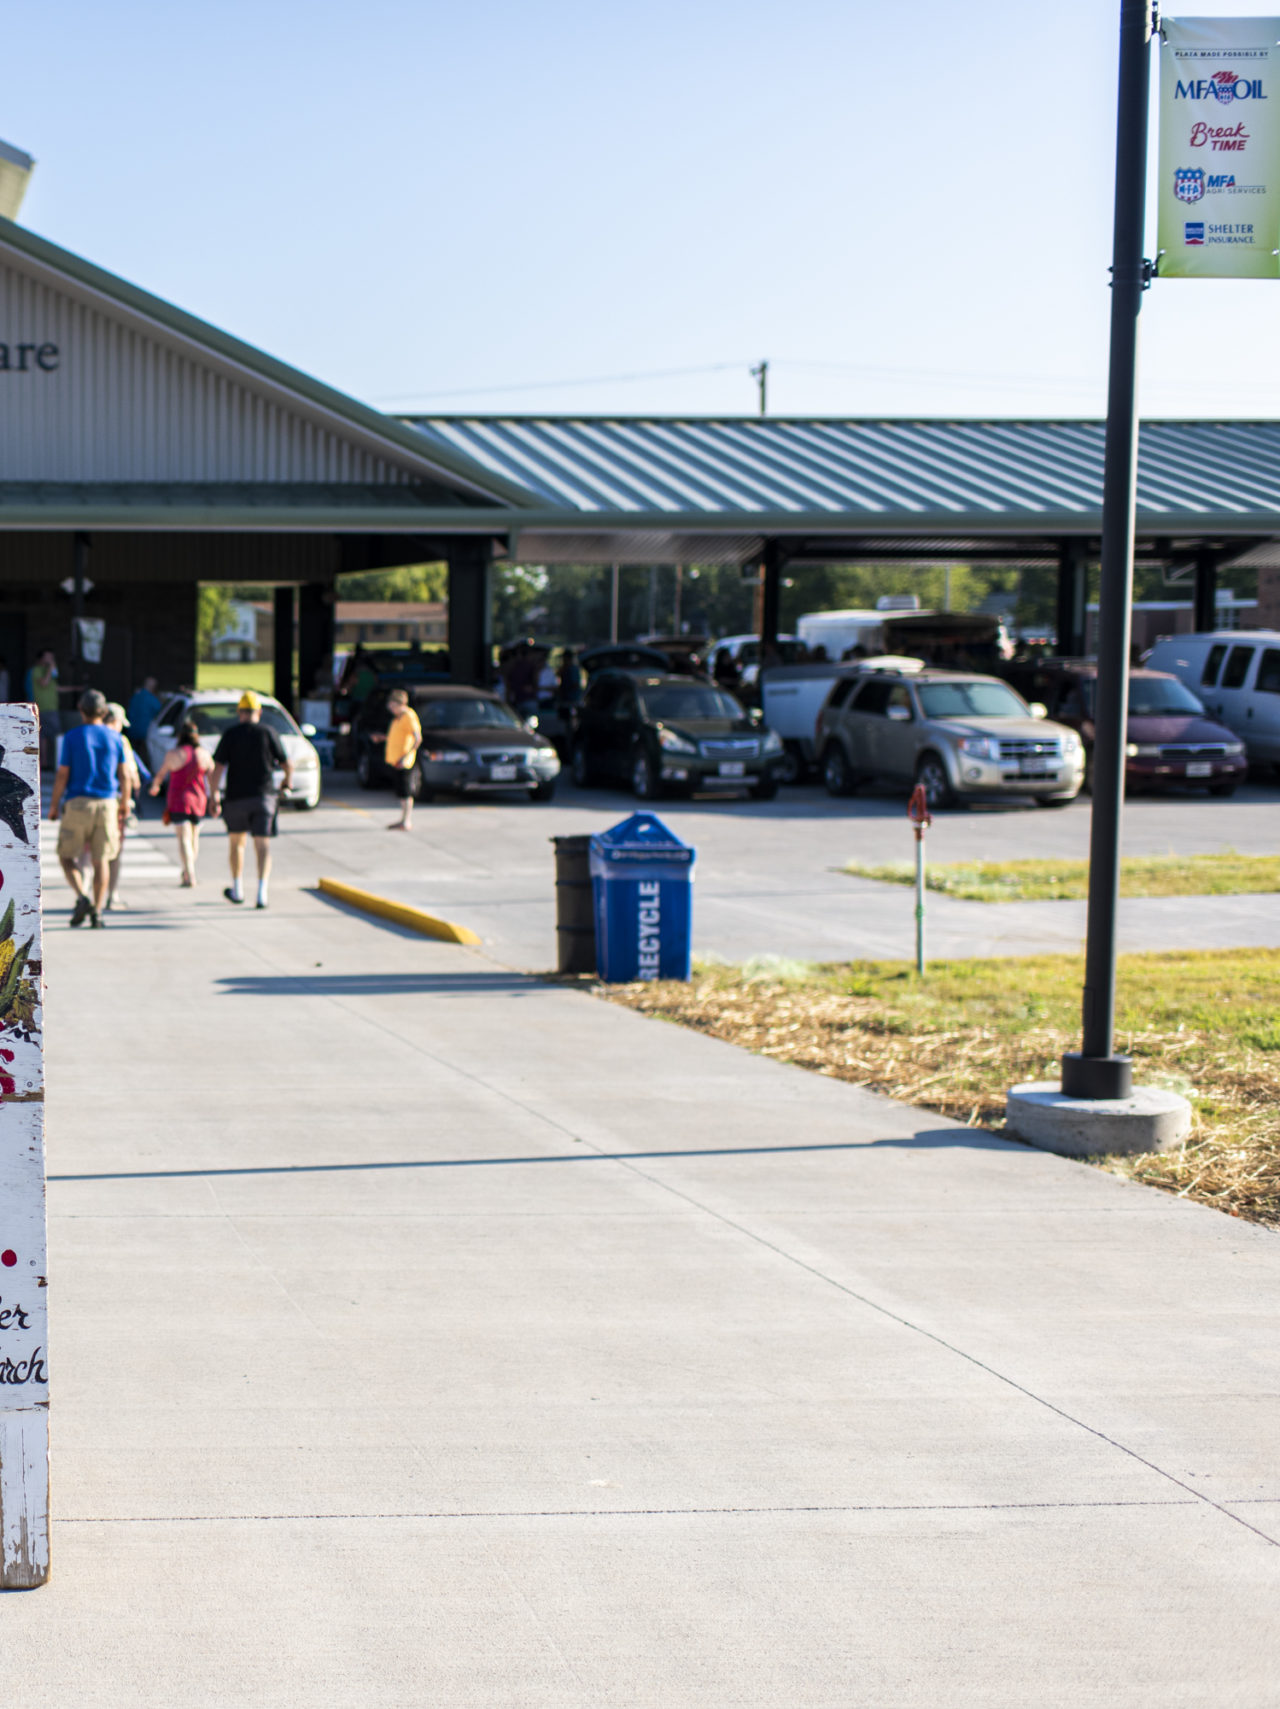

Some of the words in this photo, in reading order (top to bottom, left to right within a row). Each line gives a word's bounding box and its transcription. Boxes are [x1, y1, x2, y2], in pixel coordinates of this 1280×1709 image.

[1174, 79, 1219, 100] MFA
[1233, 79, 1268, 100] OIL
[1190, 121, 1250, 148] Break
[1211, 140, 1247, 151] TIME
[1207, 175, 1236, 188] MFA
[1208, 224, 1254, 234] SHELTER
[1208, 236, 1254, 244] INSURANCE
[638, 881, 660, 980] RECYCLE
